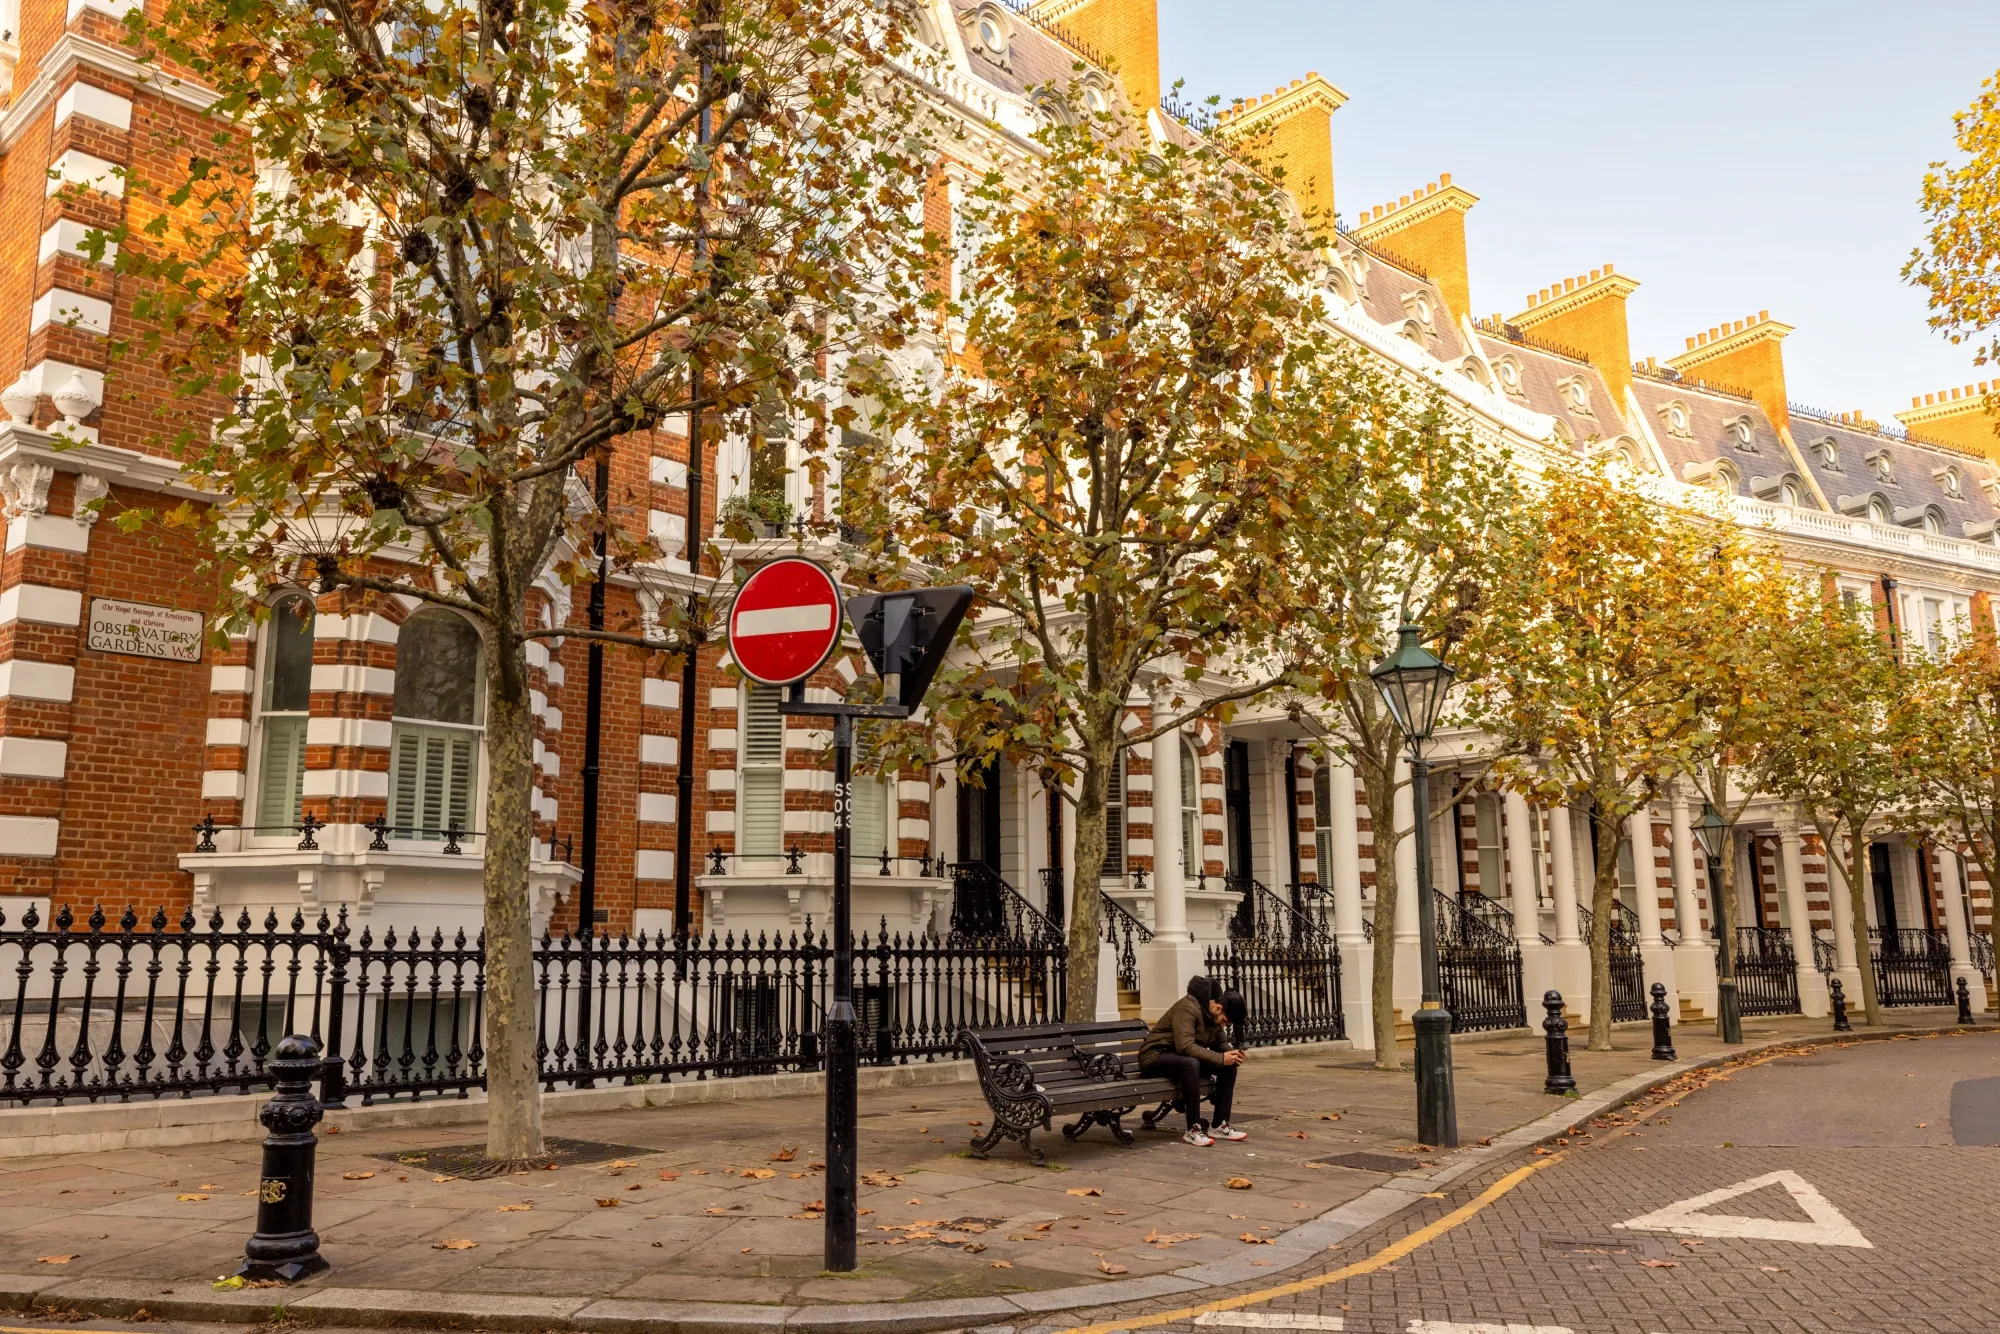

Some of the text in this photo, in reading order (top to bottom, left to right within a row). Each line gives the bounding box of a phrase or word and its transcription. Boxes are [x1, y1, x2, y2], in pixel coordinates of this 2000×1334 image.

[102, 603, 114, 611] The
[116, 605, 131, 615] Royal
[132, 607, 155, 617] Borough
[164, 613, 194, 623] Kensington
[143, 619, 165, 628] Chelsea
[1176, 848, 1184, 866] 2
[1691, 889, 1697, 901] 5
